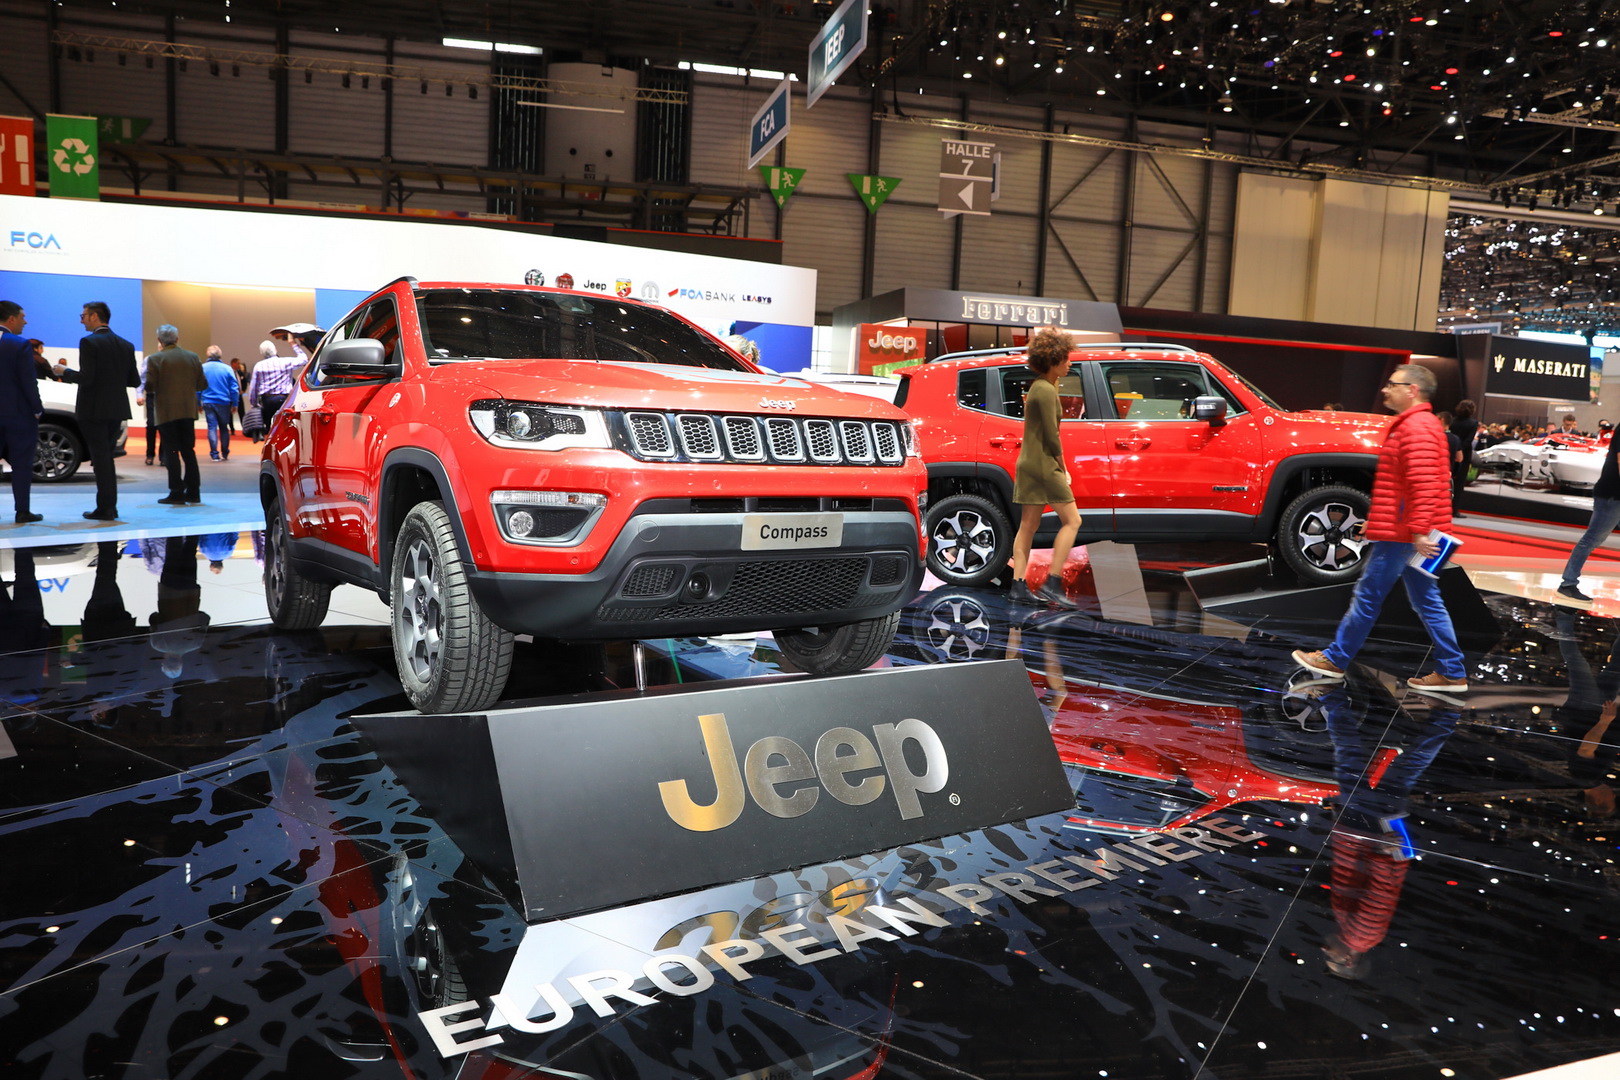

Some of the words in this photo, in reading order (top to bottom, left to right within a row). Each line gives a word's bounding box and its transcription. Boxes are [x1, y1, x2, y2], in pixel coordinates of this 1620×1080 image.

[823, 23, 846, 76] JEEP
[760, 108, 775, 143] FCA
[946, 142, 991, 159] HALLE
[961, 158, 974, 176] 7
[10, 230, 62, 250] FCA
[583, 279, 607, 291] Jeep
[680, 288, 704, 300] FCA
[705, 290, 736, 302] BANK
[742, 294, 772, 304] LEASYS
[961, 295, 1068, 326] Ferrari
[868, 330, 918, 354] Jeep
[1513, 357, 1586, 378] MASERATI
[758, 396, 796, 411] Jeep
[760, 524, 829, 543] Compass
[658, 712, 949, 832] Jeep
[417, 896, 951, 1059] EUROPEAN
[936, 816, 1268, 917] PREMIERE
